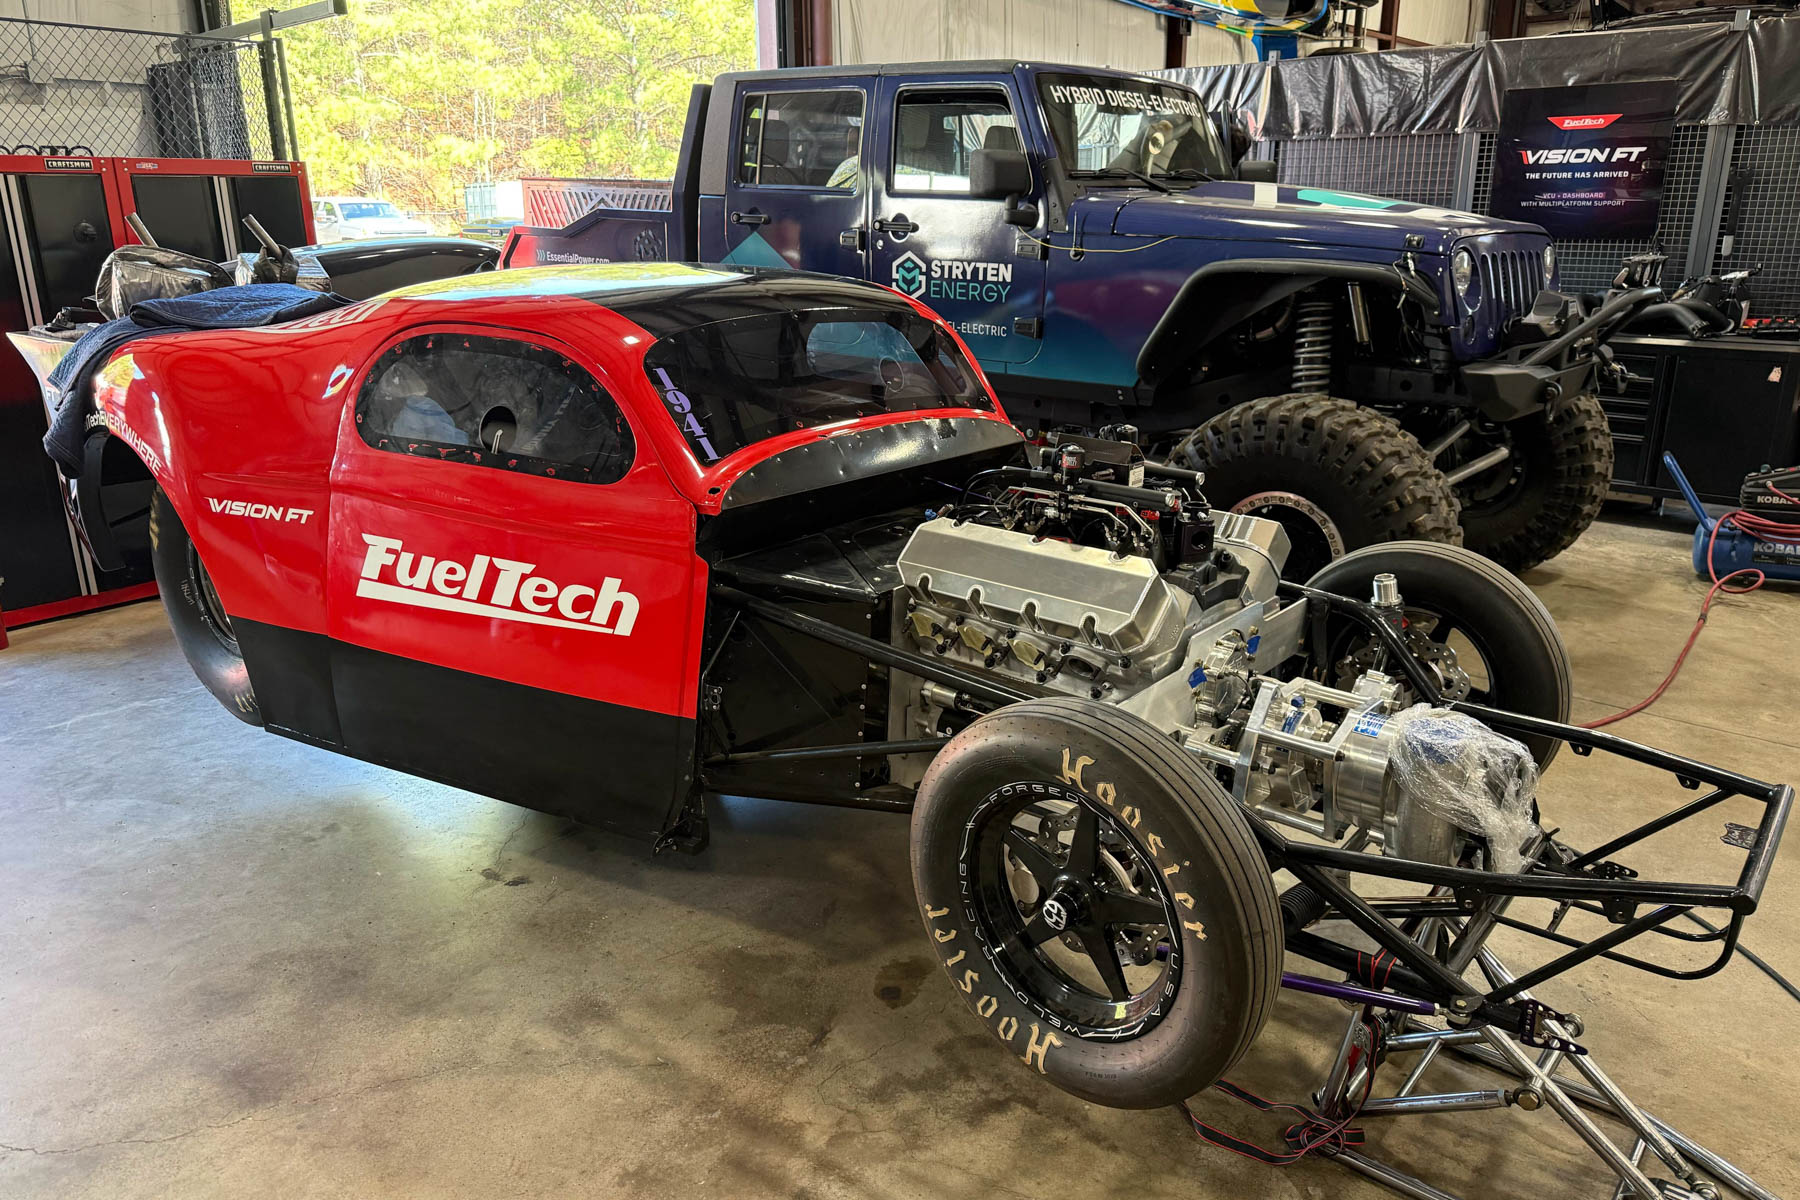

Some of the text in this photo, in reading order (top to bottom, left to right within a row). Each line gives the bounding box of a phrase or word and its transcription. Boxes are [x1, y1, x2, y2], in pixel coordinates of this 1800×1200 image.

[1050, 85, 1201, 118] HYBRID DIESEL-ELECTRIC
[1563, 118, 1605, 128] FuelTech
[48, 160, 91, 168] CRAFTSMAN
[255, 163, 289, 171] CRAFTSMAN
[1518, 146, 1648, 165] VISION FT
[1525, 172, 1540, 180] THE
[1574, 171, 1591, 179] HAS
[1593, 170, 1629, 178] ARRIVED
[1538, 199, 1593, 207] MULTIPLATFORM
[1594, 199, 1626, 207] SUPPORT
[1562, 191, 1604, 199] DASHBOARD
[930, 259, 1013, 283] STRYTEN
[930, 280, 1011, 303] ENERGY
[947, 320, 1007, 337] L-ELECTRIC
[653, 367, 721, 461] 1941
[203, 496, 315, 524] VISION FT
[357, 533, 640, 637] FuelTech
[989, 784, 1079, 805] FORGED
[1056, 747, 1208, 942] Hoosier
[958, 862, 994, 961] RACING
[924, 903, 1064, 1076] Hoosier
[1016, 991, 1082, 1038] WELD
